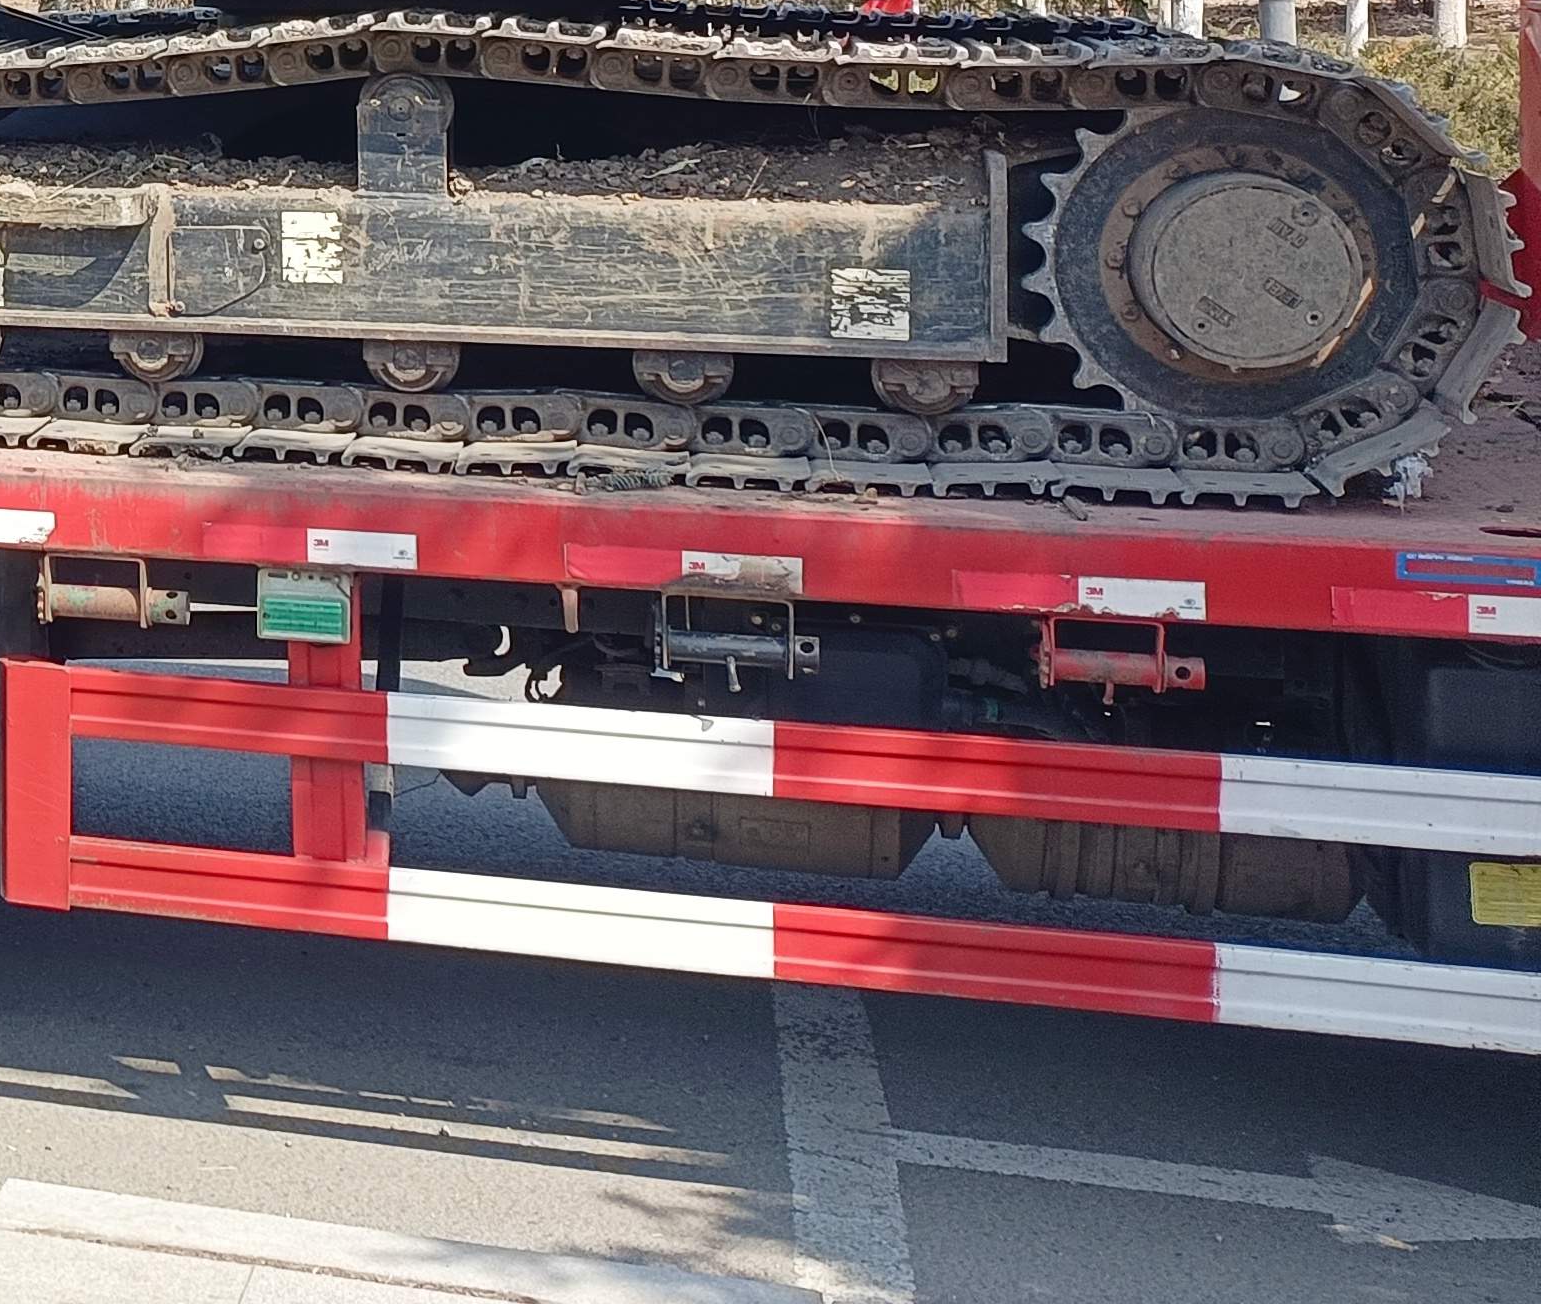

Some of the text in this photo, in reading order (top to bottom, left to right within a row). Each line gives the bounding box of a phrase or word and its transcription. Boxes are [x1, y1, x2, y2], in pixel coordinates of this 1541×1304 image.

[689, 562, 705, 570] 3M
[1085, 587, 1104, 596] 3M
[1477, 606, 1496, 615] 3M
